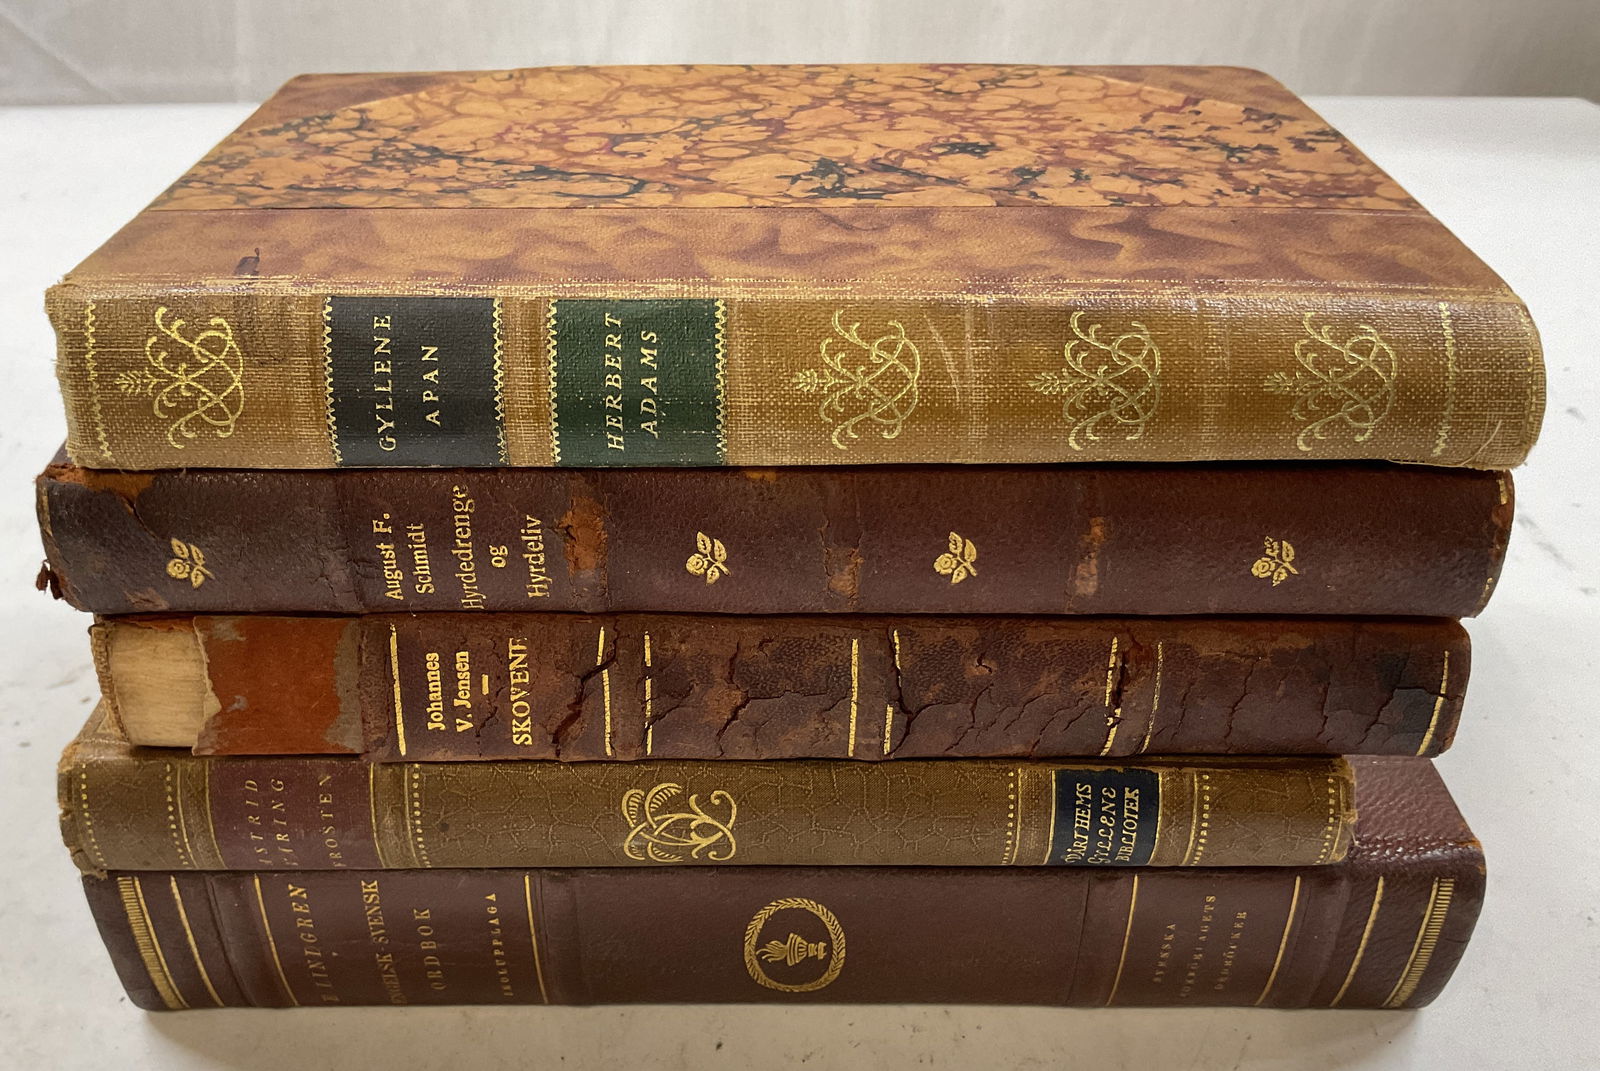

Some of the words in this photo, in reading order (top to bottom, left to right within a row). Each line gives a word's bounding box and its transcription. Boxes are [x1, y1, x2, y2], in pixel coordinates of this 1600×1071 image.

[373, 315, 397, 452] GYLLENE
[421, 345, 442, 427] APAN
[604, 312, 625, 452] HERBERT
[640, 330, 659, 439] ADAMS
[372, 513, 392, 533] F.
[406, 523, 435, 595] Schmidt
[451, 484, 487, 610] Hyrdedrenge
[489, 544, 508, 568] og
[520, 514, 552, 598] Hyrdeliv
[376, 542, 404, 600] August
[426, 652, 446, 731] Johannes
[453, 651, 472, 709] Jensen
[455, 713, 473, 732] V.
[413, 908, 447, 991] ORDBOK
